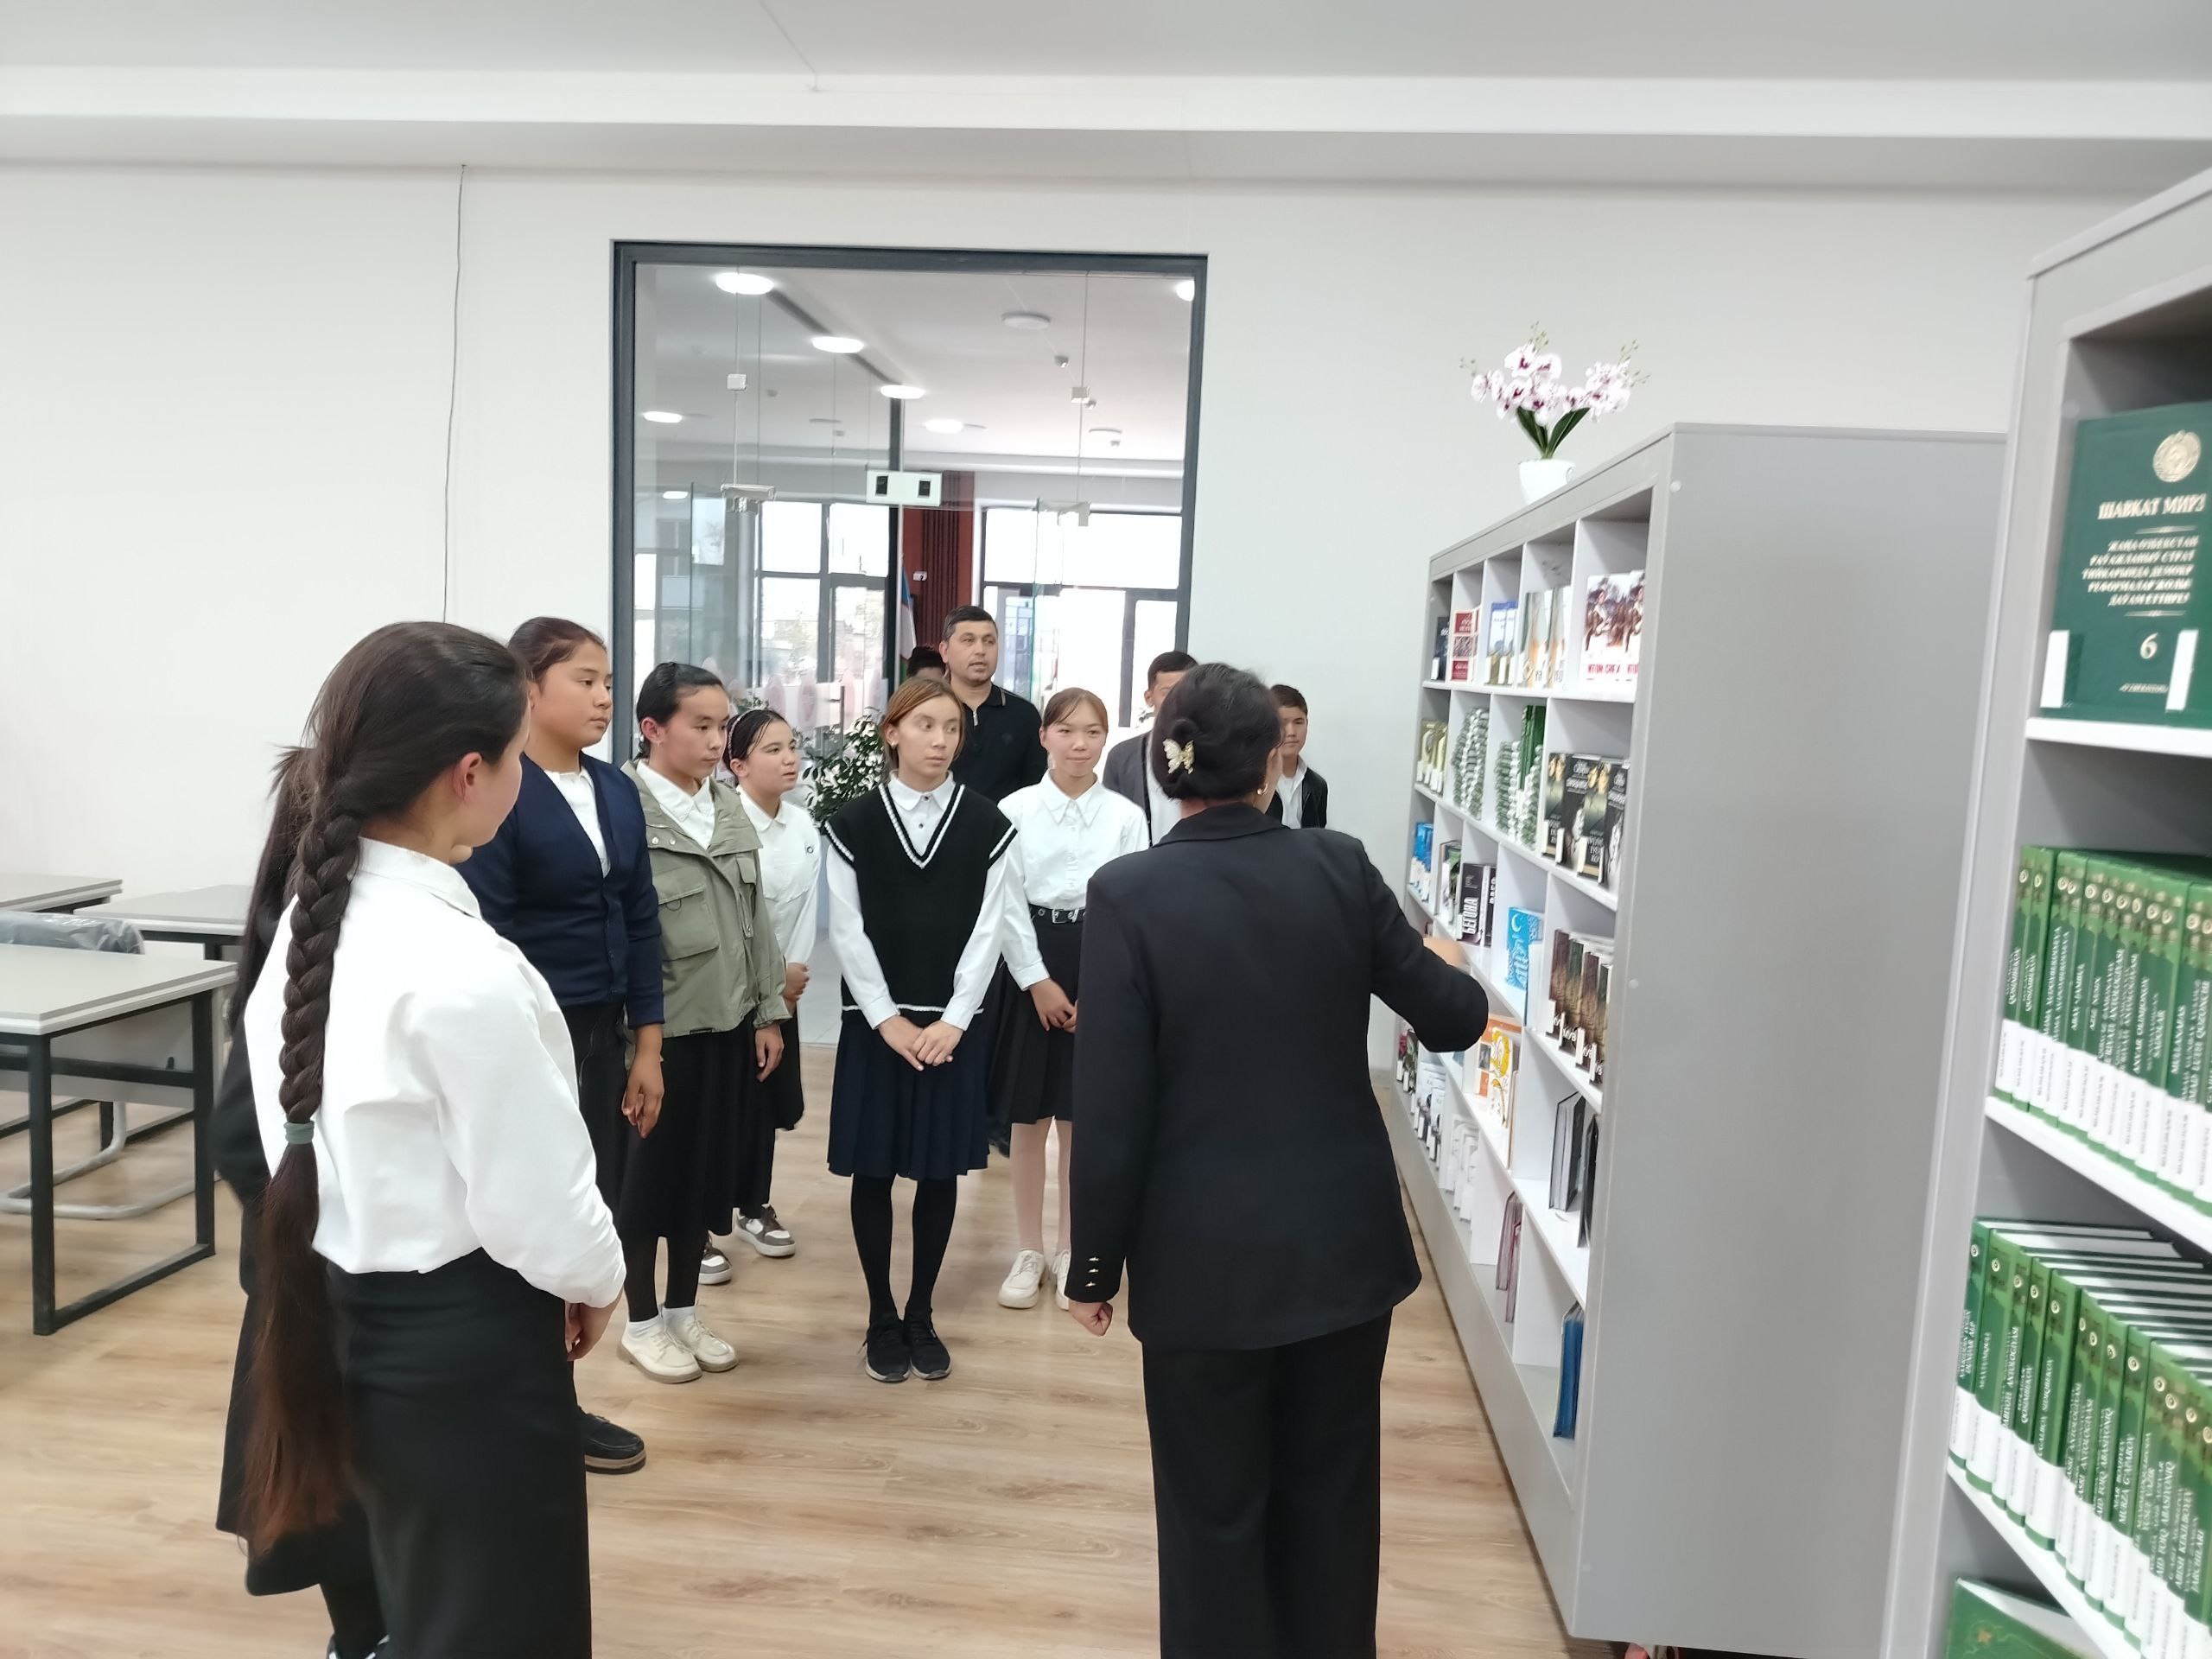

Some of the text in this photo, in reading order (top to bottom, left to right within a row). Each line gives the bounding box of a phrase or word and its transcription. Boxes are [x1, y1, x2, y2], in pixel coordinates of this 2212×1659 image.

[2097, 497, 2162, 520] ШАВКАТ
[2139, 632, 2159, 660] 6
[2044, 1008, 2052, 1036] ALIMA
[2133, 1039, 2143, 1074] ANVAR
[2157, 1557, 2165, 1578] AID
